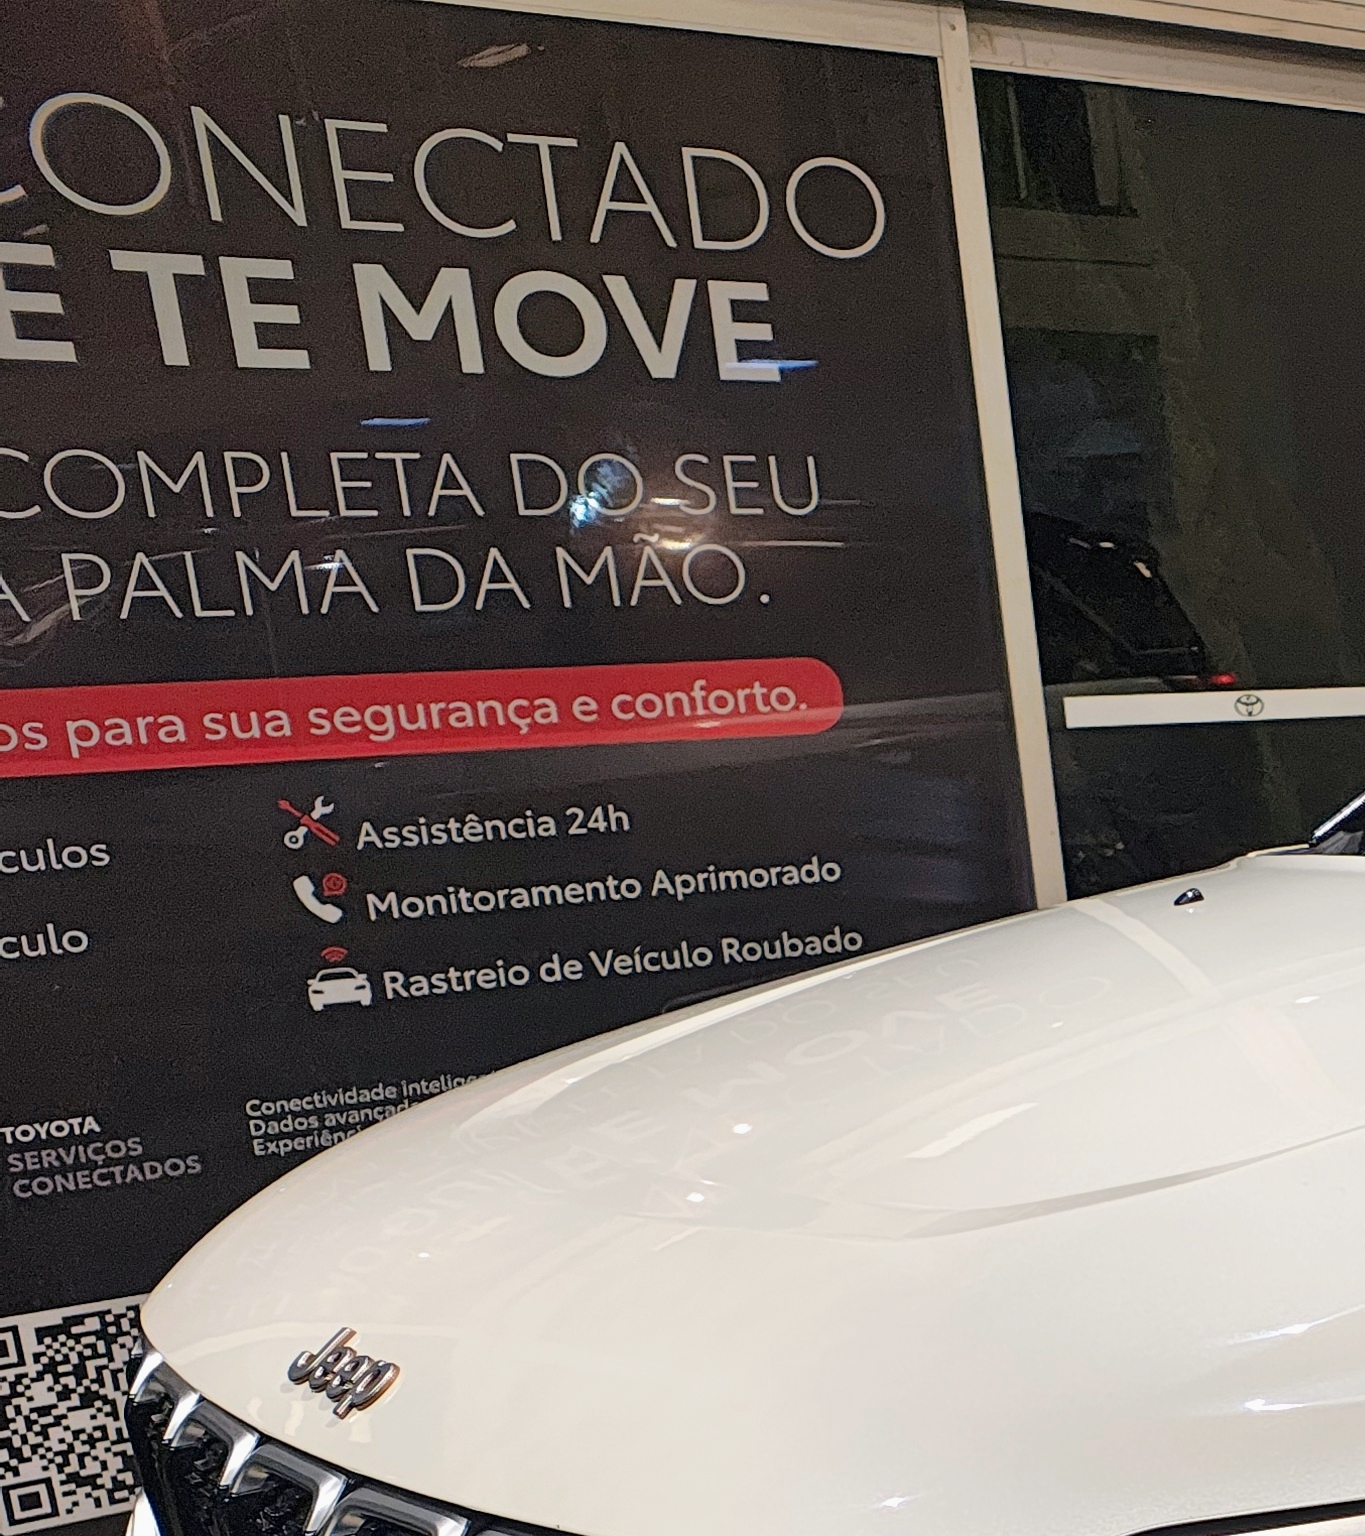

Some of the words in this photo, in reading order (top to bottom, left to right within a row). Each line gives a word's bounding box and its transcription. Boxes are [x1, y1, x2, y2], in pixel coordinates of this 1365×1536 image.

[0, 92, 887, 259] ONECTADO
[109, 249, 312, 371] TE
[353, 262, 783, 382] MOVE
[511, 451, 645, 518] DO
[673, 453, 821, 518] SEU
[61, 546, 380, 622] PALMA
[405, 546, 532, 614] DA
[556, 533, 773, 610] MÃO.
[66, 714, 187, 759] para
[203, 707, 292, 742] sua
[310, 694, 560, 742] segurança
[572, 694, 600, 724] e
[610, 678, 809, 722] conforto.
[355, 806, 559, 852] Assistência
[565, 804, 632, 838] 24h
[366, 871, 643, 924] Monitoramento
[650, 854, 844, 907] Aprimorado
[383, 957, 530, 1000] Rastreio
[539, 951, 585, 986] de
[589, 940, 715, 982] Veículo
[721, 924, 865, 965] Roubado
[2, 1115, 101, 1145] TOYOTA
[245, 1083, 398, 1118] Conectividade
[249, 1113, 319, 1137] Dados
[8, 1137, 145, 1174] SERVIÇOS
[13, 1155, 202, 1199] CONECTADOS
[287, 1327, 401, 1420] Jeep
